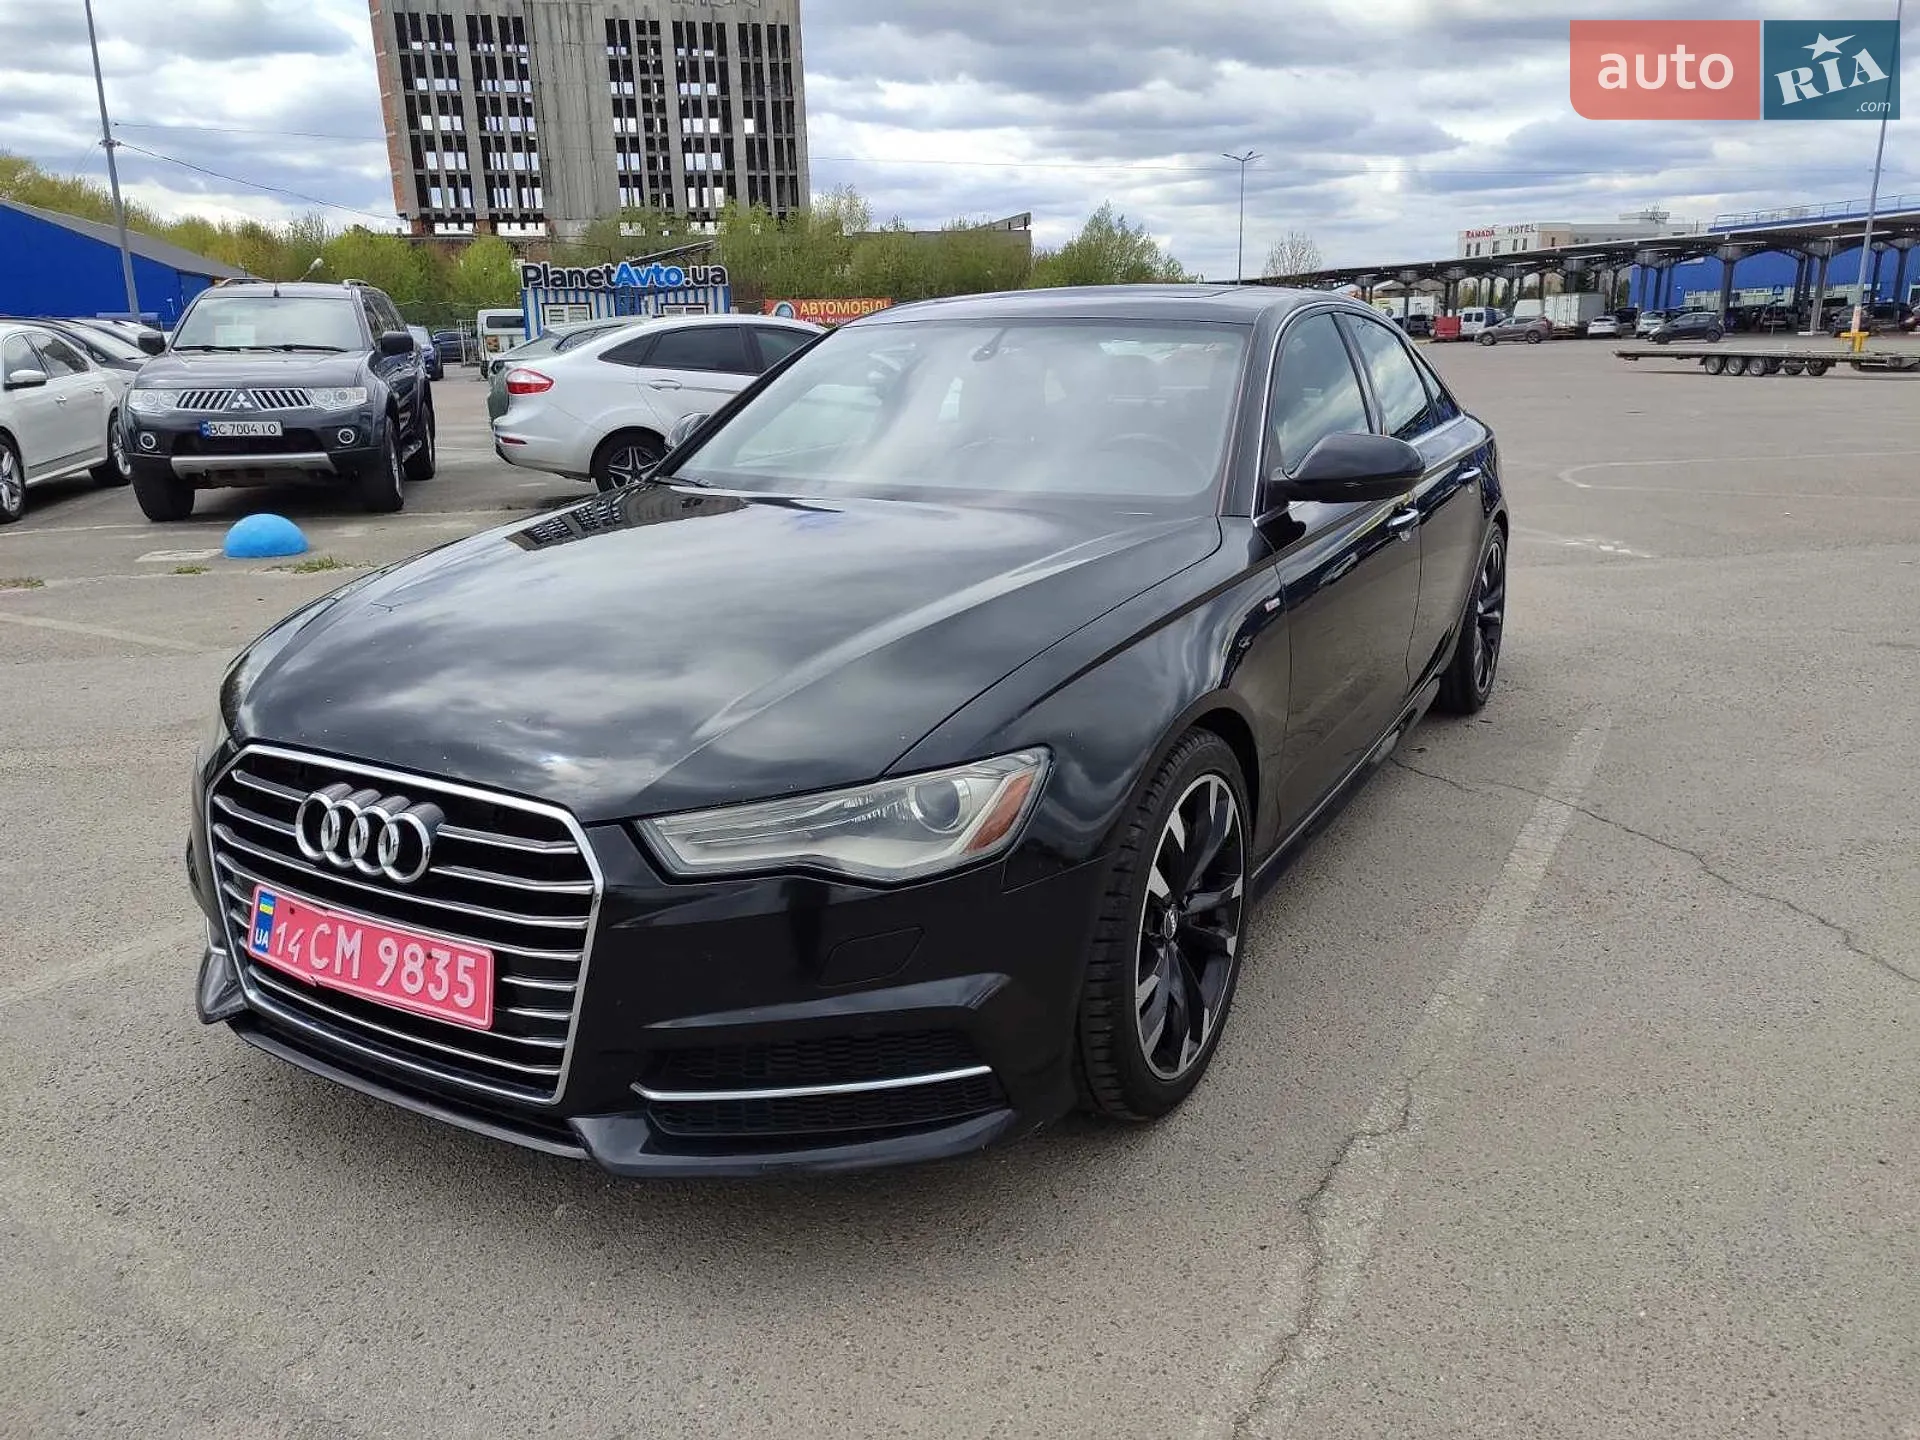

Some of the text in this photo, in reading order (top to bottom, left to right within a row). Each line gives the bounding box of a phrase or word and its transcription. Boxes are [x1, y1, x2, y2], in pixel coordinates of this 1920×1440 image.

[1508, 223, 1535, 234] HOTEL
[521, 261, 729, 289] PlanetAvto.ua
[230, 424, 257, 434] 7004
[255, 929, 269, 949] UA
[376, 937, 476, 1009] 9835
